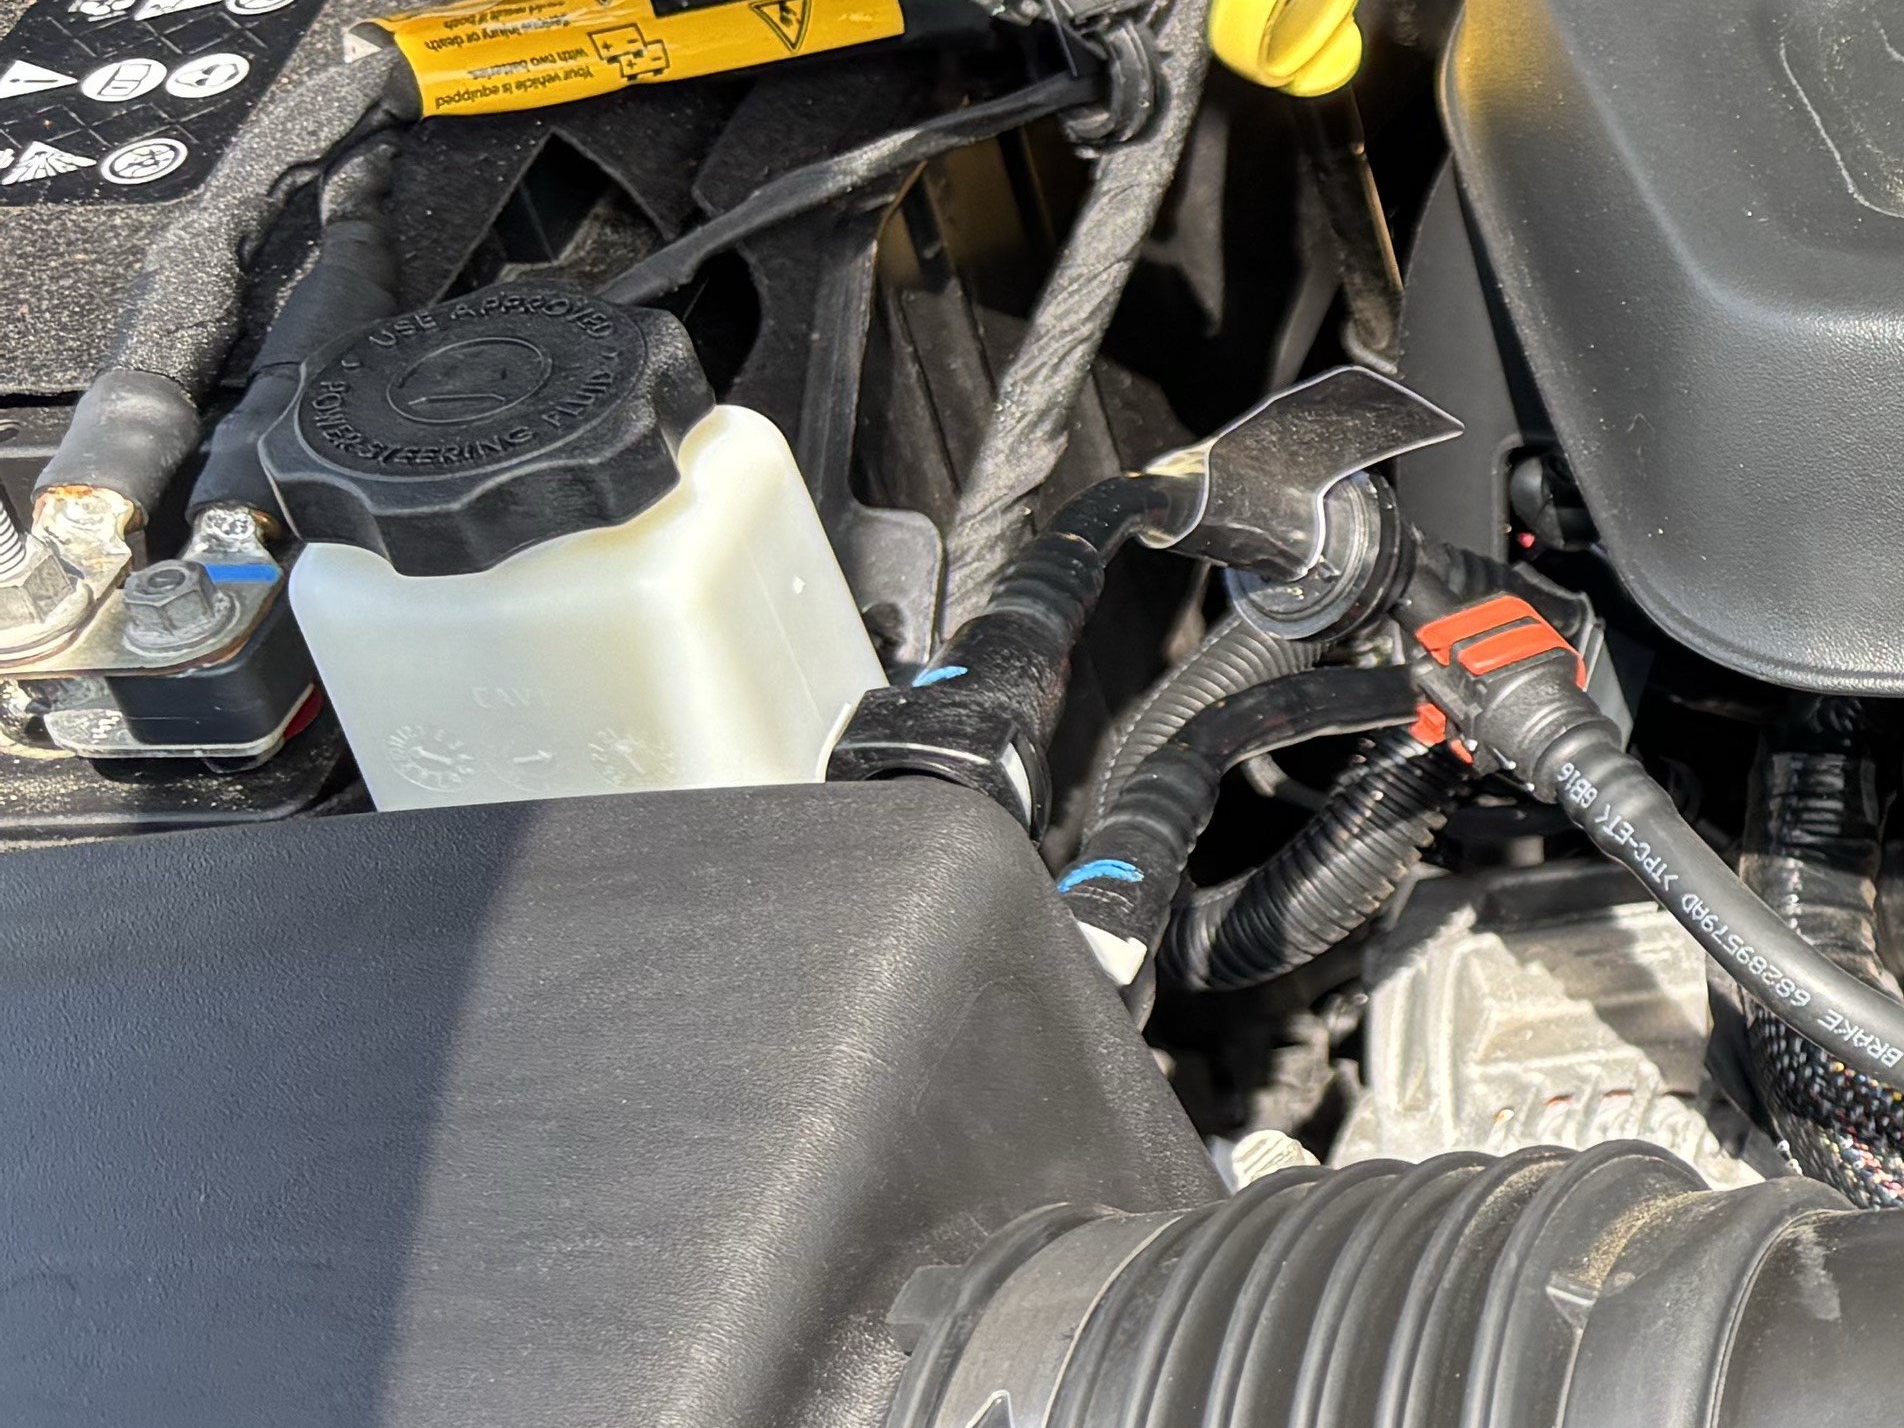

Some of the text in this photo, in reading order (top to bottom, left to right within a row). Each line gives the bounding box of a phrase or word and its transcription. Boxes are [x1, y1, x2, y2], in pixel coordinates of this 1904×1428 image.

[423, 32, 465, 52] death
[530, 55, 555, 68] two
[567, 64, 595, 82] Your
[516, 71, 564, 91] vehicle
[434, 84, 500, 110] equipped
[368, 290, 614, 348] USE APPROVED
[541, 368, 617, 427] FLUID
[1681, 893, 1812, 1007] 68289579AD
